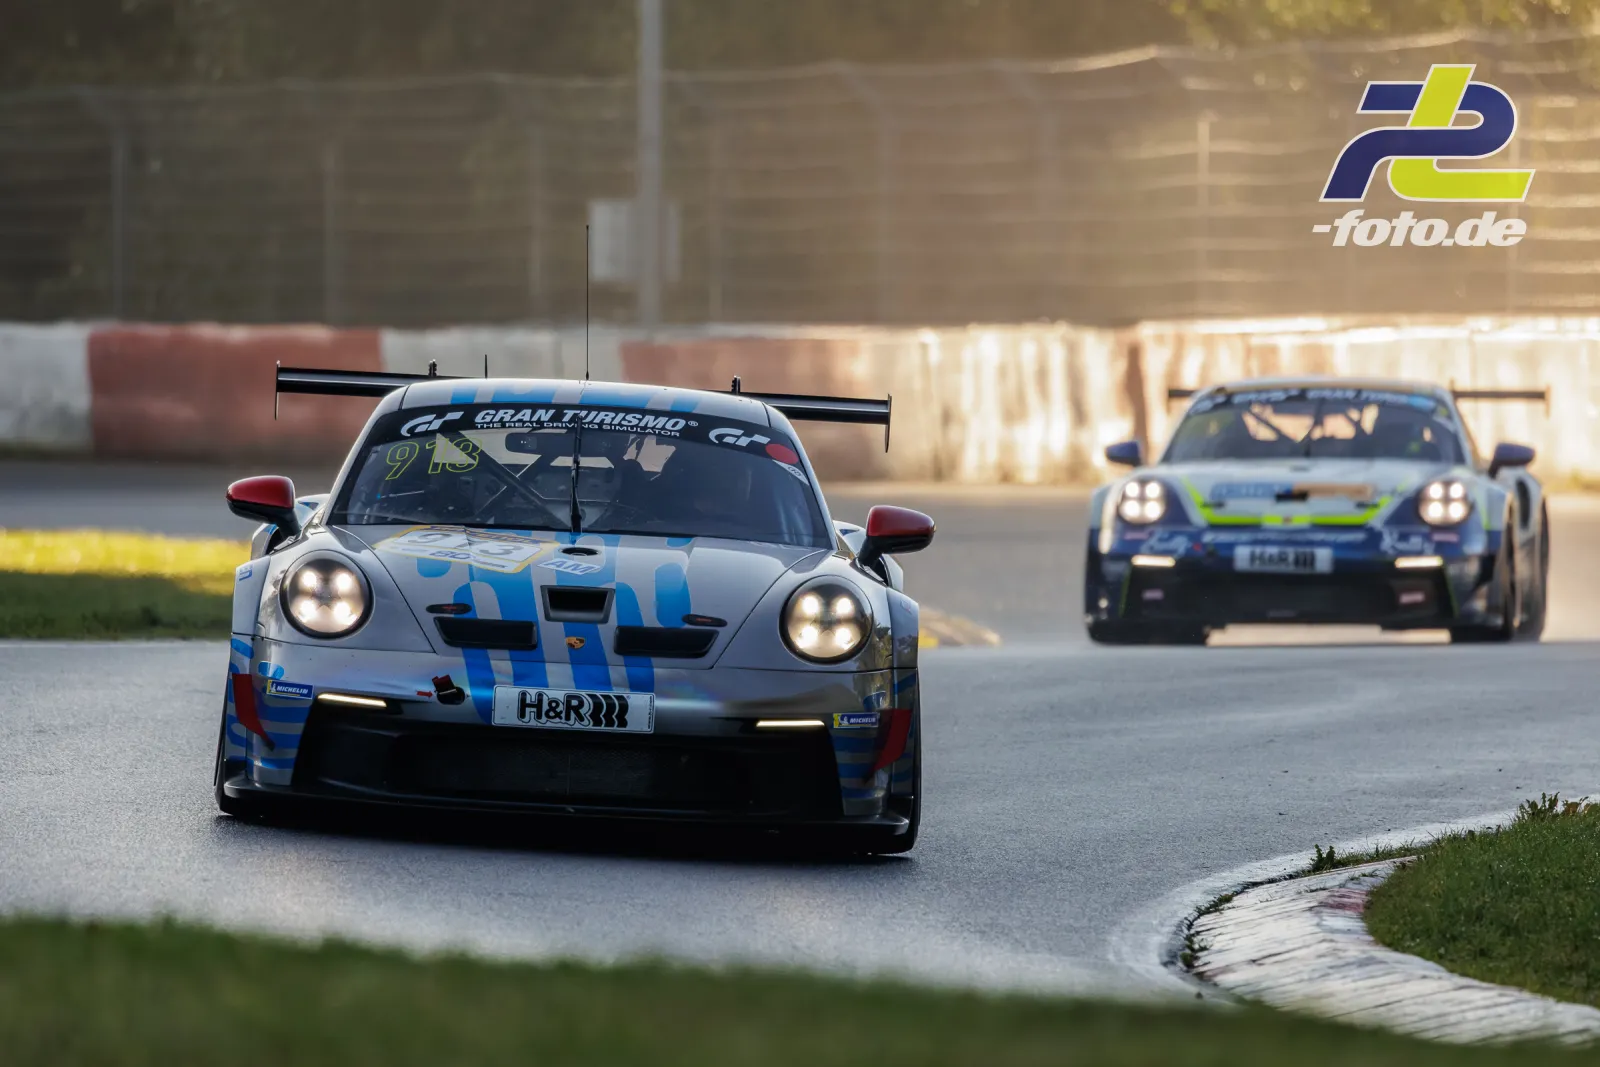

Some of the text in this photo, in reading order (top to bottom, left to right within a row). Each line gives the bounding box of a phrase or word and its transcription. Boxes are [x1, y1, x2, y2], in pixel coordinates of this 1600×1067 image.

[474, 408, 555, 423] GRAN
[602, 424, 680, 437] SIMULATOR
[544, 559, 595, 574] AM
[276, 686, 309, 695] MICHELIN
[518, 690, 590, 727] H&R
